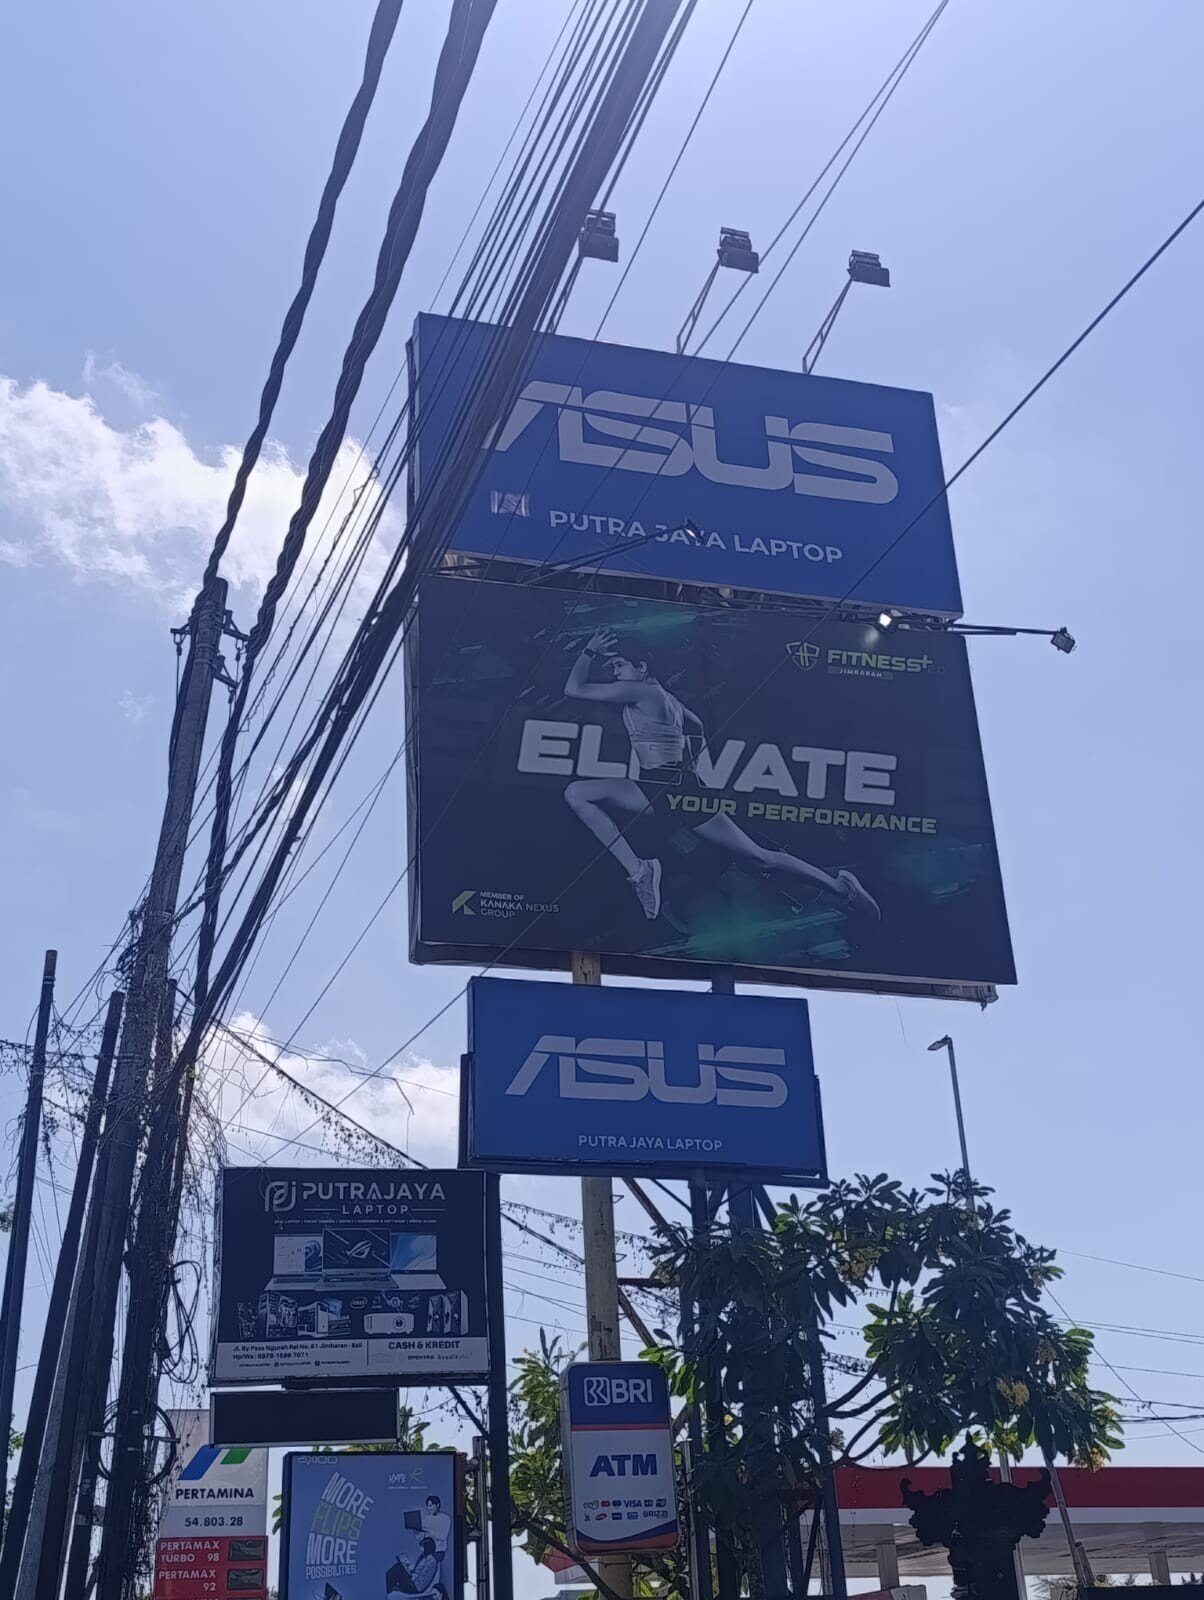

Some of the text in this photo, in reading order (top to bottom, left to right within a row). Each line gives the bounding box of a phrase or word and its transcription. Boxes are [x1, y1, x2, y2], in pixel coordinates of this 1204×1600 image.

[482, 380, 898, 504] ASUS
[549, 510, 843, 563] PUTRA JAA LAPTOP
[666, 793, 938, 835] YOUR PERFORMANCE
[480, 890, 525, 902] MEMBER OF
[480, 898, 560, 914] KANAKA NEXUS
[480, 908, 516, 919] GROUP
[504, 1035, 788, 1109] ASUS
[578, 1135, 723, 1152] PUTRA JAYA LAPTOP
[303, 1182, 446, 1200] PUTRAJAYA
[342, 1204, 410, 1216] LAPTOP
[388, 1340, 461, 1350] CASH & KREDIT
[611, 1378, 653, 1403] BRI
[589, 1453, 658, 1478] ATM
[175, 1487, 255, 1500] PERTAMINA
[321, 1471, 375, 1520] MORE
[623, 1499, 642, 1508] VISA
[184, 1516, 244, 1527] 54.803.28
[311, 1501, 363, 1540] FLIPS
[160, 1540, 220, 1551] PERTAMAX
[306, 1532, 359, 1565] MORE
[160, 1552, 220, 1563] TURBO 98
[158, 1569, 216, 1580] PERTAMAX
[305, 1564, 357, 1580] POSSIBILITIES
[203, 1582, 216, 1592] 92
